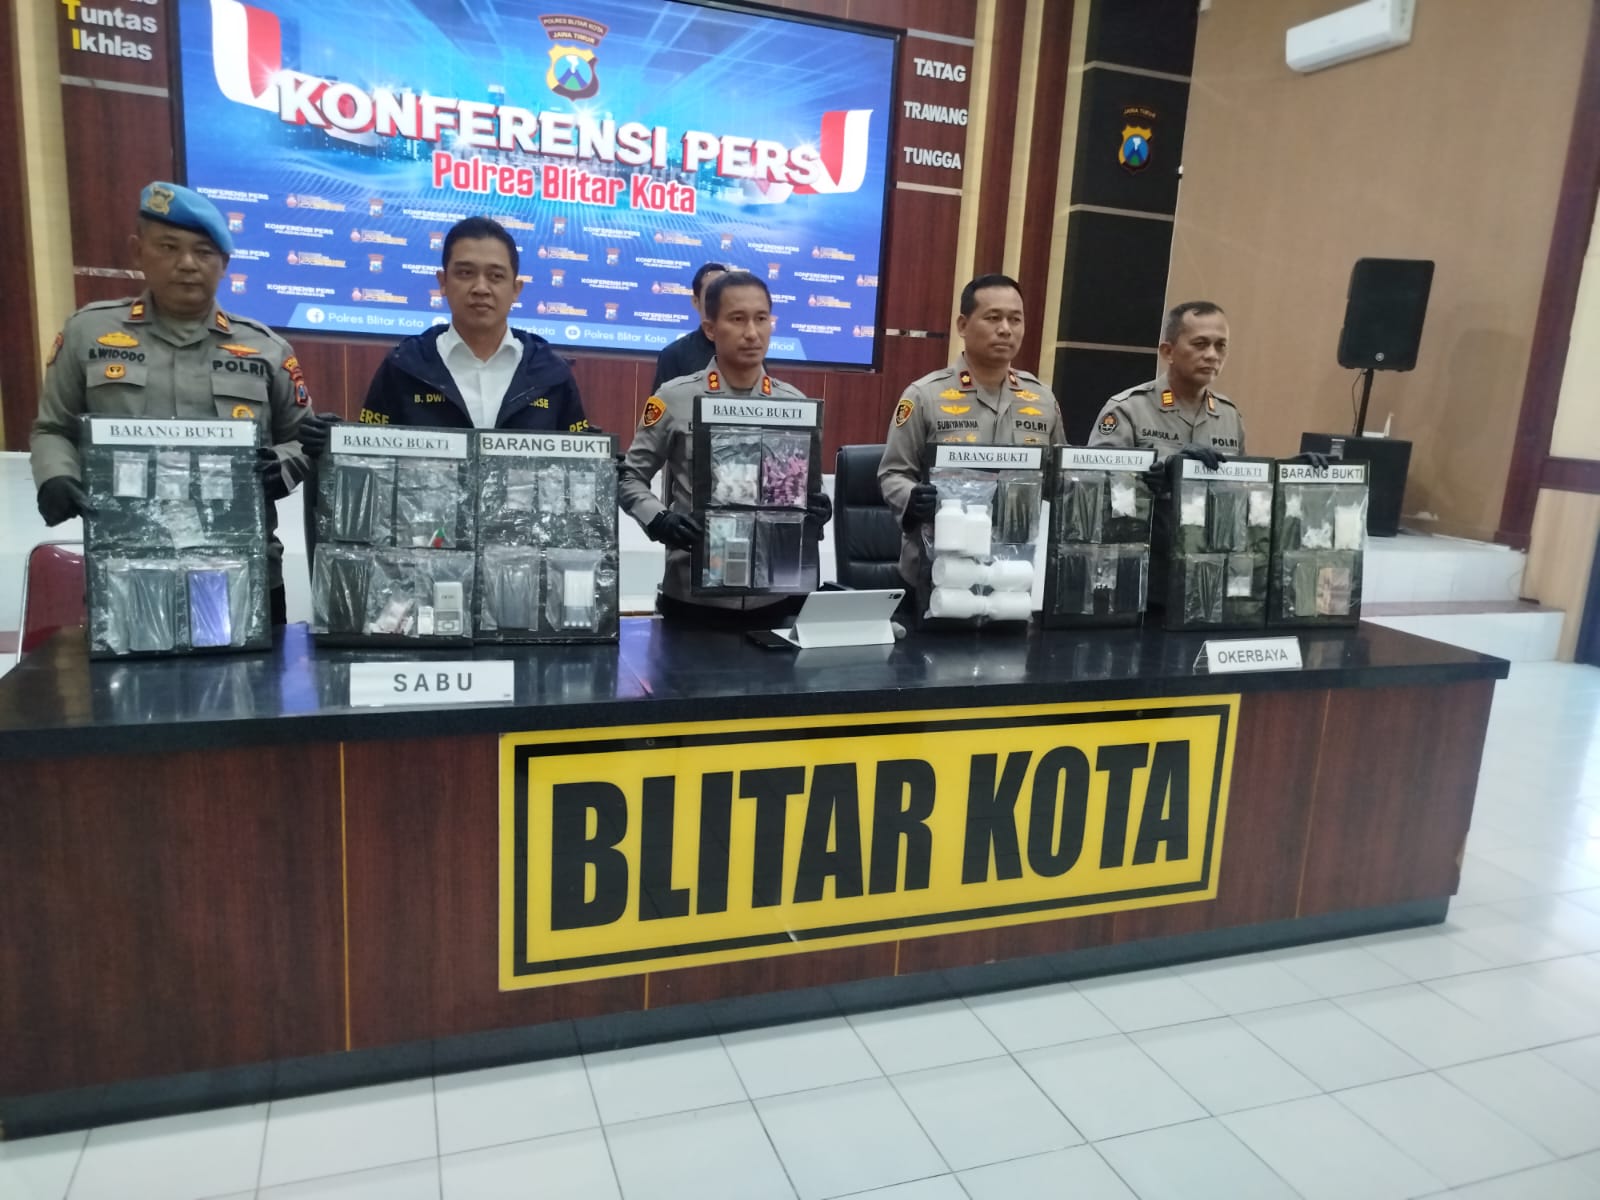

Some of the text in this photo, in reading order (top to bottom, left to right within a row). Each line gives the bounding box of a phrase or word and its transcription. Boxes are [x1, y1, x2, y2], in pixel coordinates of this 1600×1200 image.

[61, 0, 158, 33] Tuntas
[72, 28, 153, 61] Ikhlas
[914, 57, 967, 83] TATAG
[904, 101, 968, 126] TRAWANG
[276, 77, 822, 186] KONFERENSI PERS
[904, 146, 962, 171] TUNGGA
[432, 151, 697, 214] Polres Blitar Kota
[328, 312, 424, 328] Polres Blitar Kota
[584, 329, 668, 344] Polres Blitar Kota
[212, 360, 264, 376] POLRI
[713, 404, 803, 419] BARANG BUKTI
[110, 424, 235, 439] BARANG BUKTI
[1015, 420, 1047, 432] POLRI
[343, 434, 450, 450] BARANG BUKTI
[482, 436, 611, 454] BARANG BUKTI
[1211, 437, 1238, 448] POLRI
[948, 451, 1029, 463] BARANG BUKTI
[1073, 453, 1144, 465] BARANG BUKTI
[1235, 466, 1262, 477] BUKTI
[1281, 467, 1363, 479] BARANG BUKTI
[1217, 647, 1289, 665] OKERBAYA
[392, 671, 474, 692] SABU
[550, 739, 1191, 932] BLITAR KOTA
